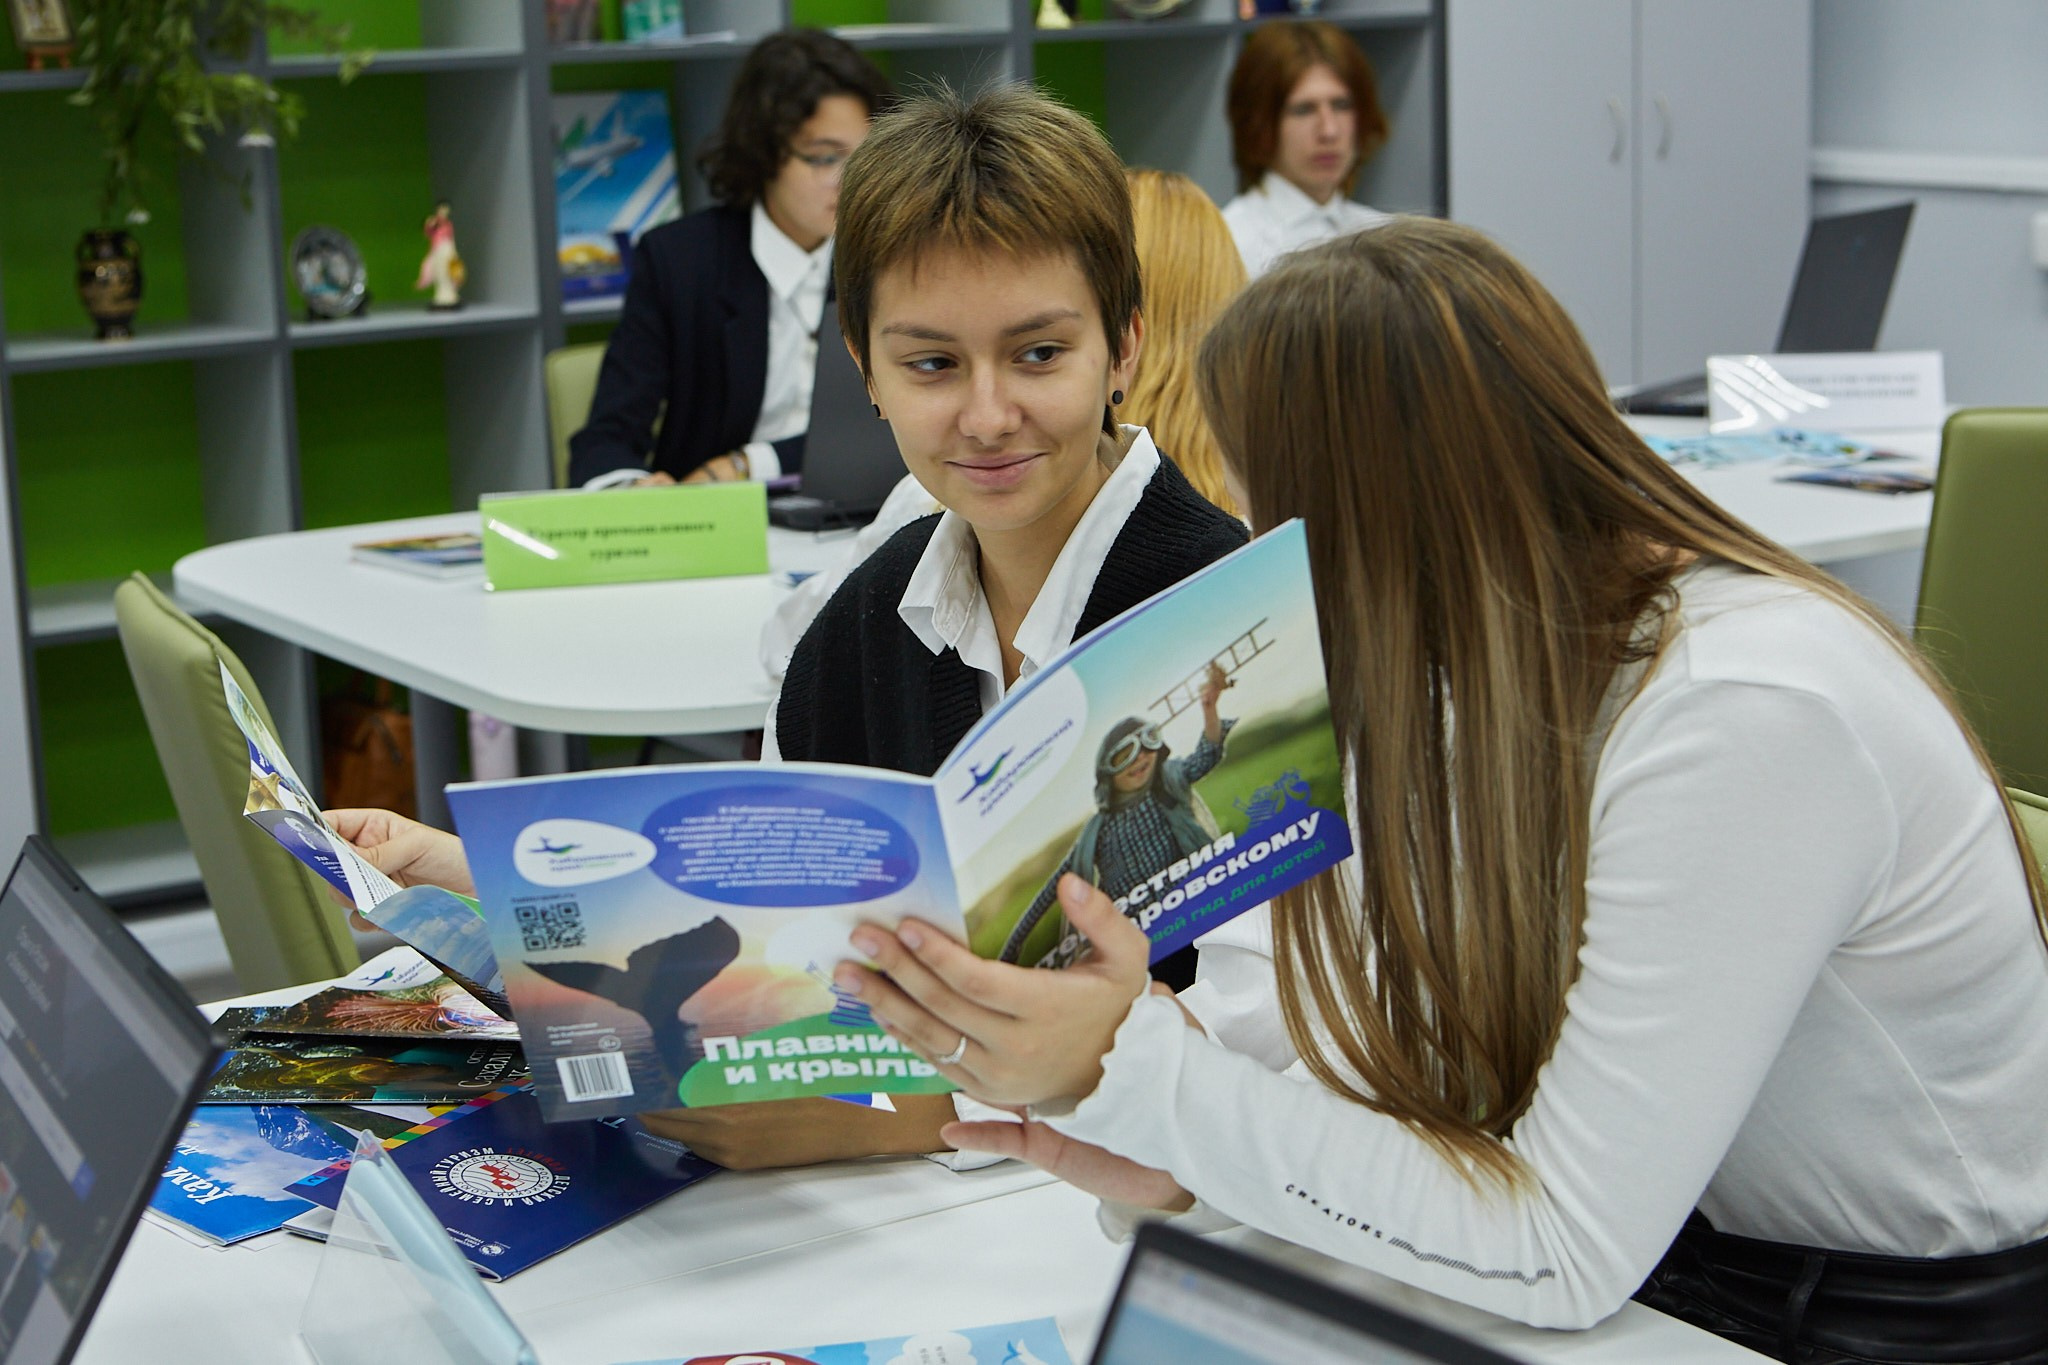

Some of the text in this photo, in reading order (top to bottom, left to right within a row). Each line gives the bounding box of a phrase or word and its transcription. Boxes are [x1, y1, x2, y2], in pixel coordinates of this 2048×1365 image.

[1190, 896, 1227, 922] гид
[1230, 873, 1267, 902] для
[1271, 838, 1326, 879] детей
[702, 1034, 910, 1062] Плавни
[723, 1058, 939, 1085] и крыль
[435, 1147, 495, 1169] ТУРИЗМ
[161, 1161, 234, 1205] Кам
[1285, 1183, 1383, 1239] CREATORS
